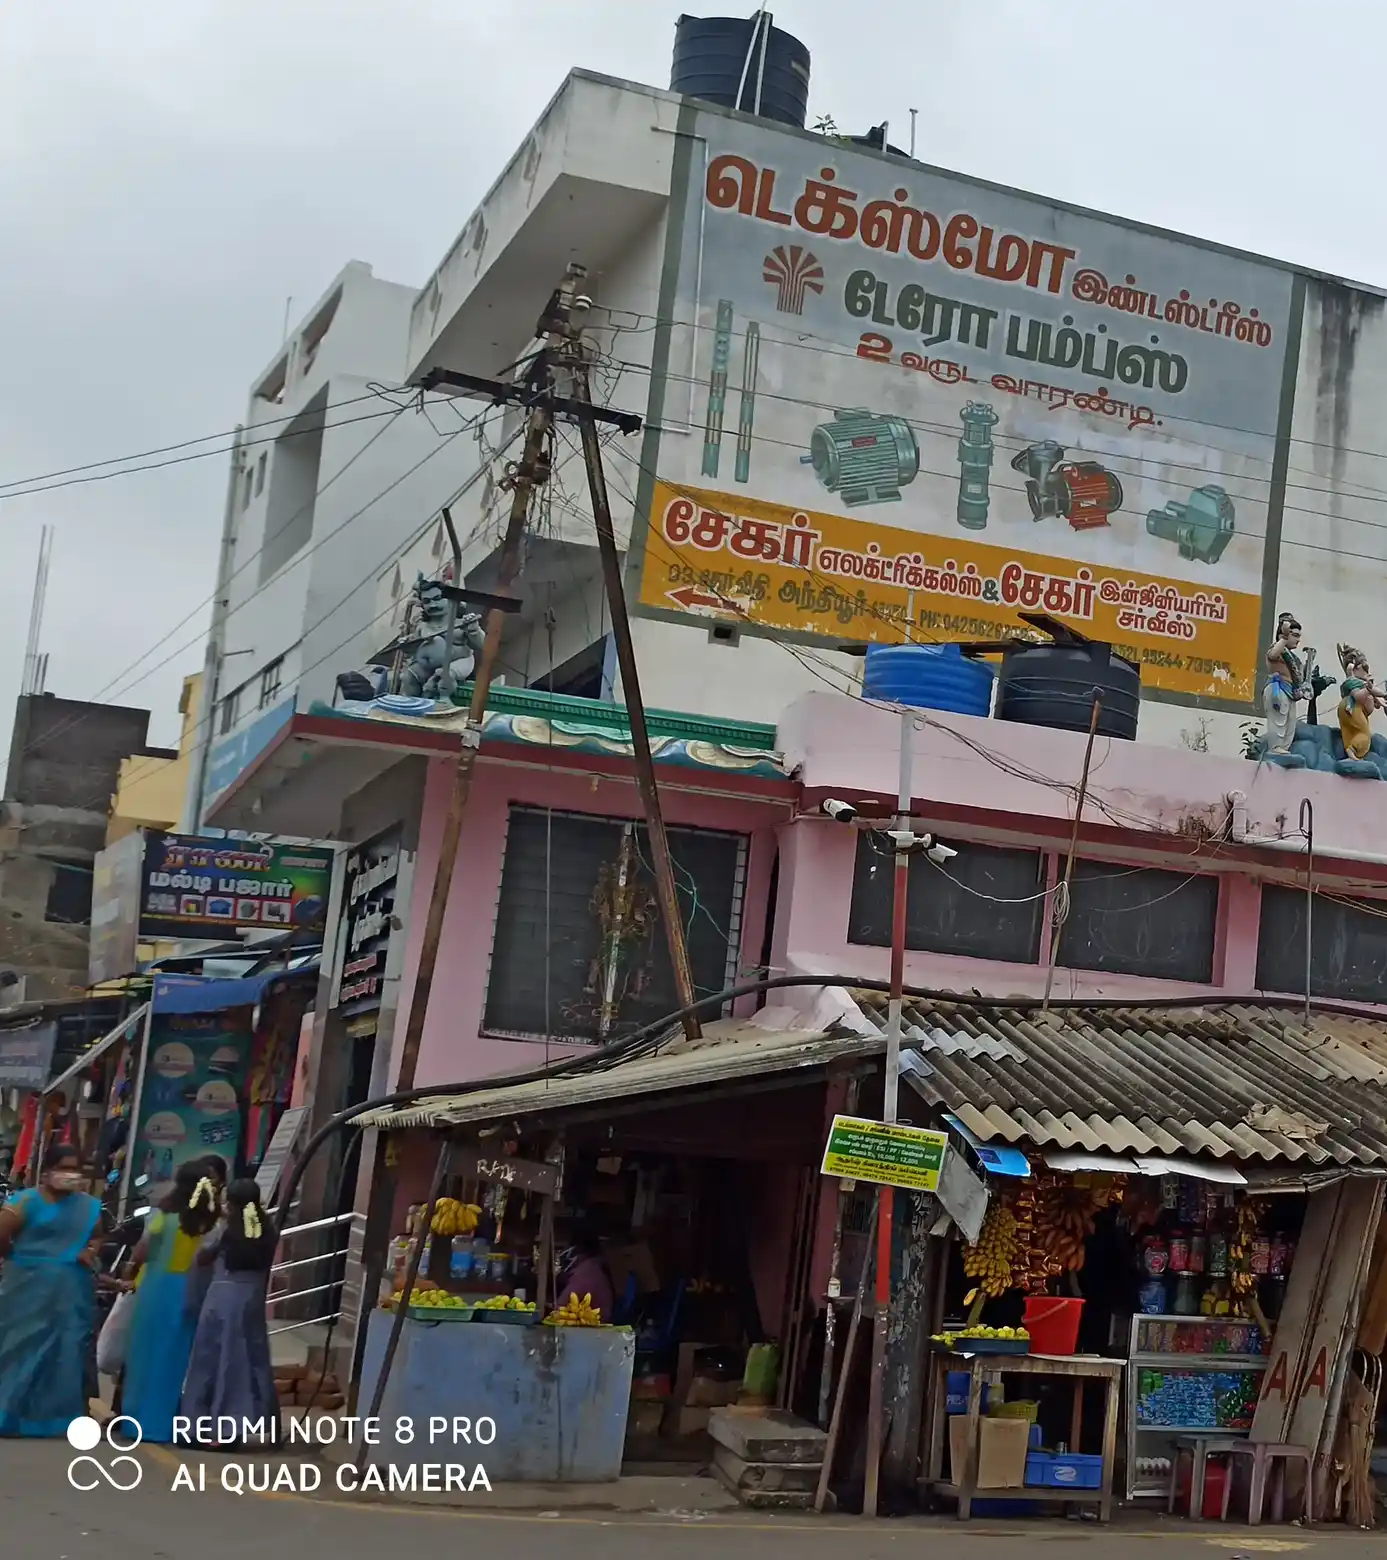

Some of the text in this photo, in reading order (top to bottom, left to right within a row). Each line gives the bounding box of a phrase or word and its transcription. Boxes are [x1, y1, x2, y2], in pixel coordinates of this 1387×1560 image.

[705, 154, 1272, 347] டெக்ஸ்மோ இண்டஸ்ட்ரீஸ்
[844, 269, 1189, 394] டேரோ பம்ப்ஸ்
[856, 332, 893, 363] 2
[901, 351, 978, 384] வருட
[665, 500, 1226, 620] சேகர் எலக்ட்ரிக்கல்ஸ் & சேகர் இன்ஜினியரிங்
[1118, 608, 1194, 638] சர்வீஸ்
[149, 869, 293, 898] மல்டி பஜார்
[1261, 1346, 1327, 1403] A A
